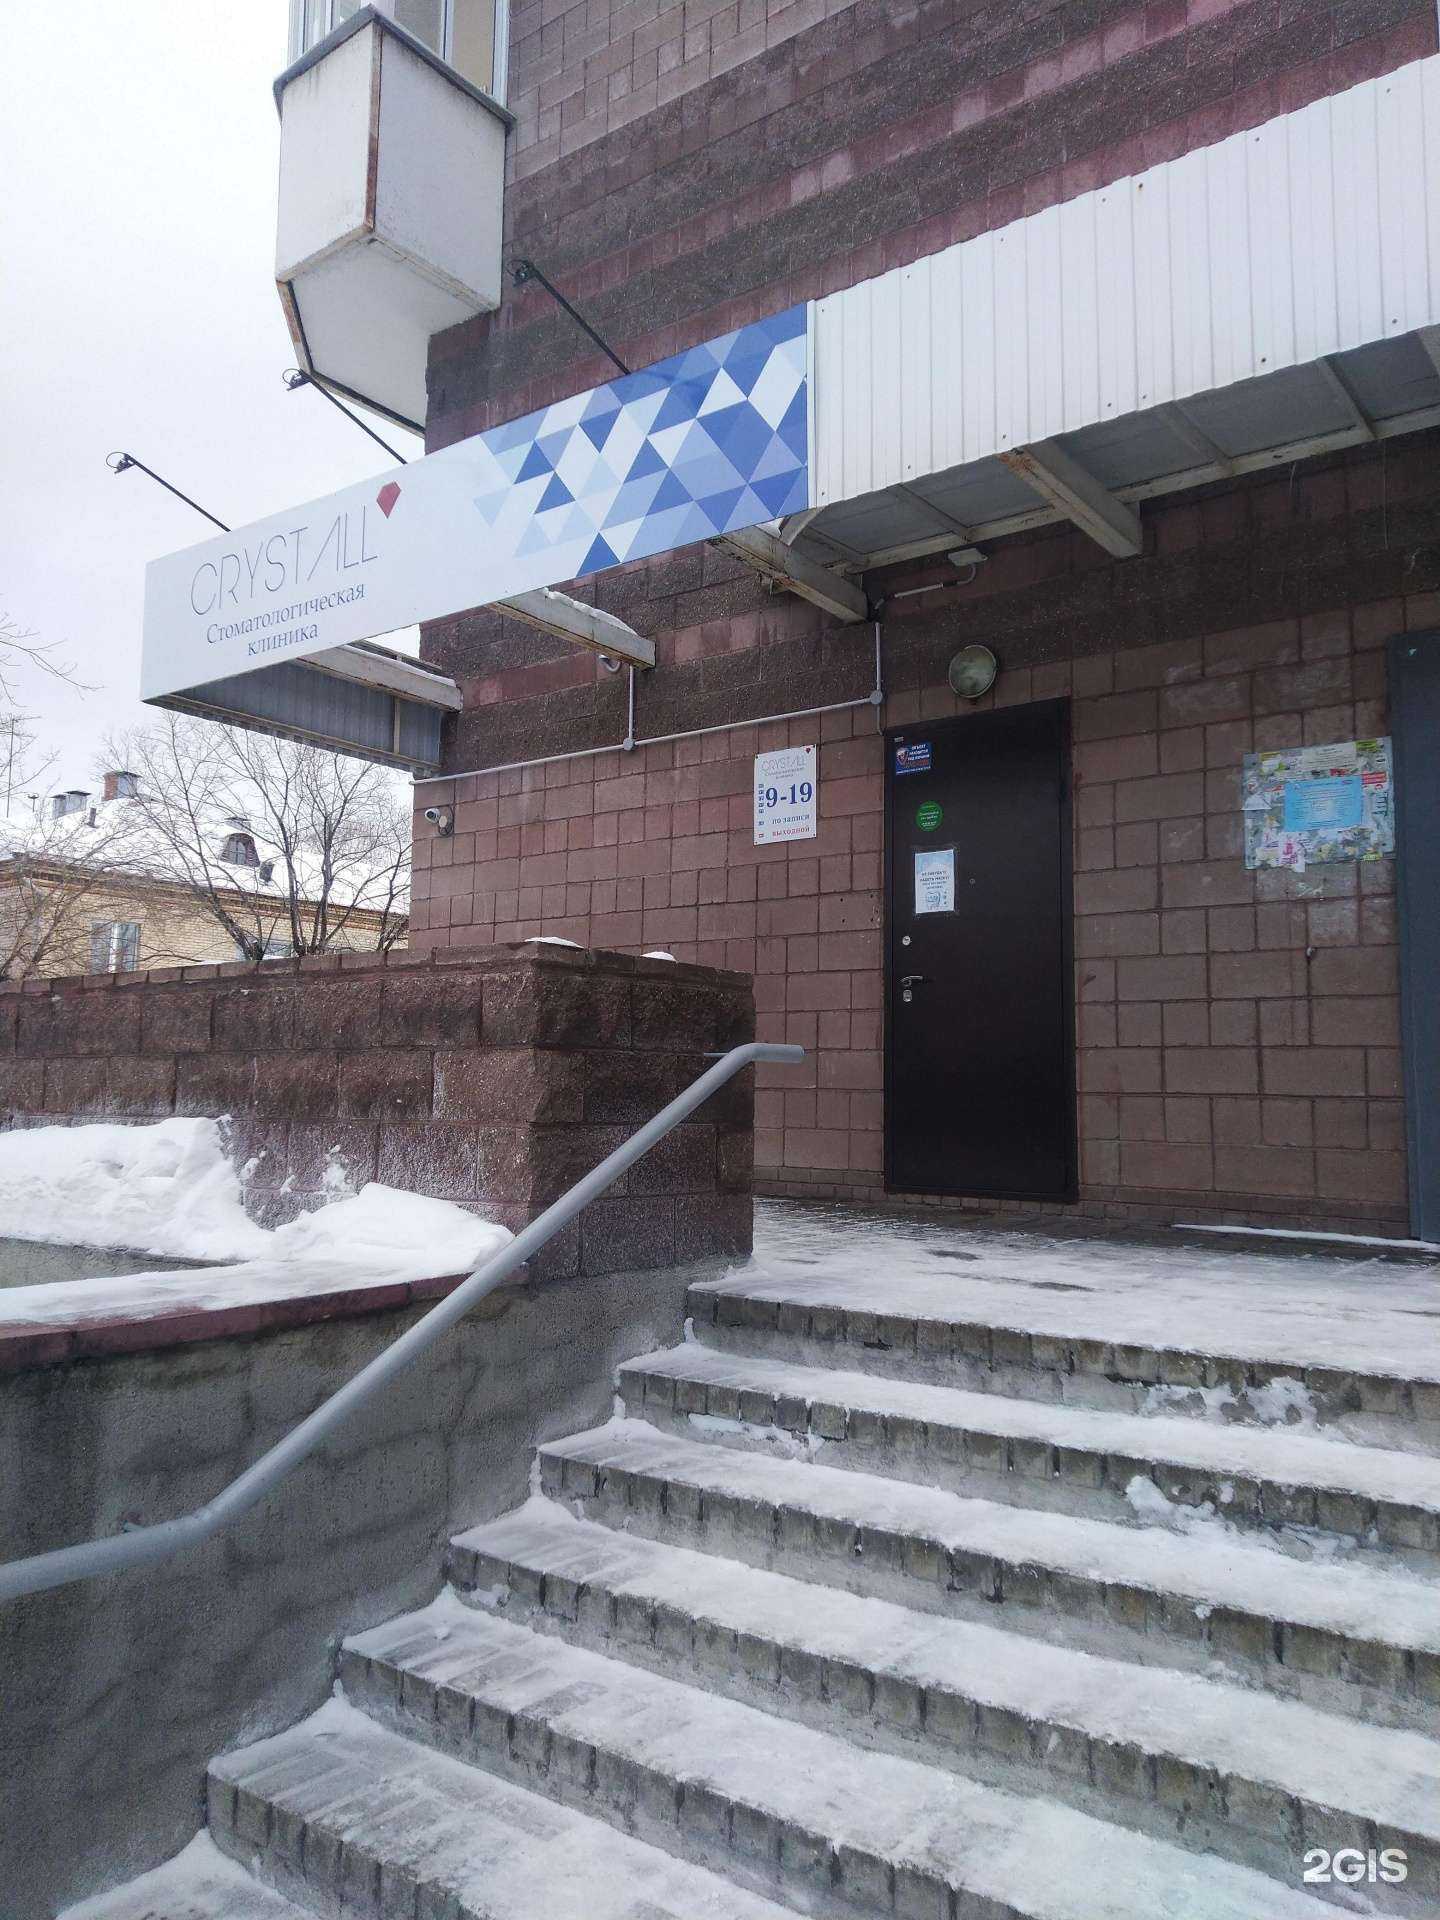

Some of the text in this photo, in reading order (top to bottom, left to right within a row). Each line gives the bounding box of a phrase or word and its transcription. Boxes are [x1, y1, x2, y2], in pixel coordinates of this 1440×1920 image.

[190, 505, 378, 616] CRYSTALL
[206, 583, 366, 645] Стоматологическая
[247, 623, 319, 656] клиника
[765, 782, 813, 808] 9-19
[772, 817, 782, 825] по
[782, 814, 810, 824] записи
[773, 826, 810, 837] выходной
